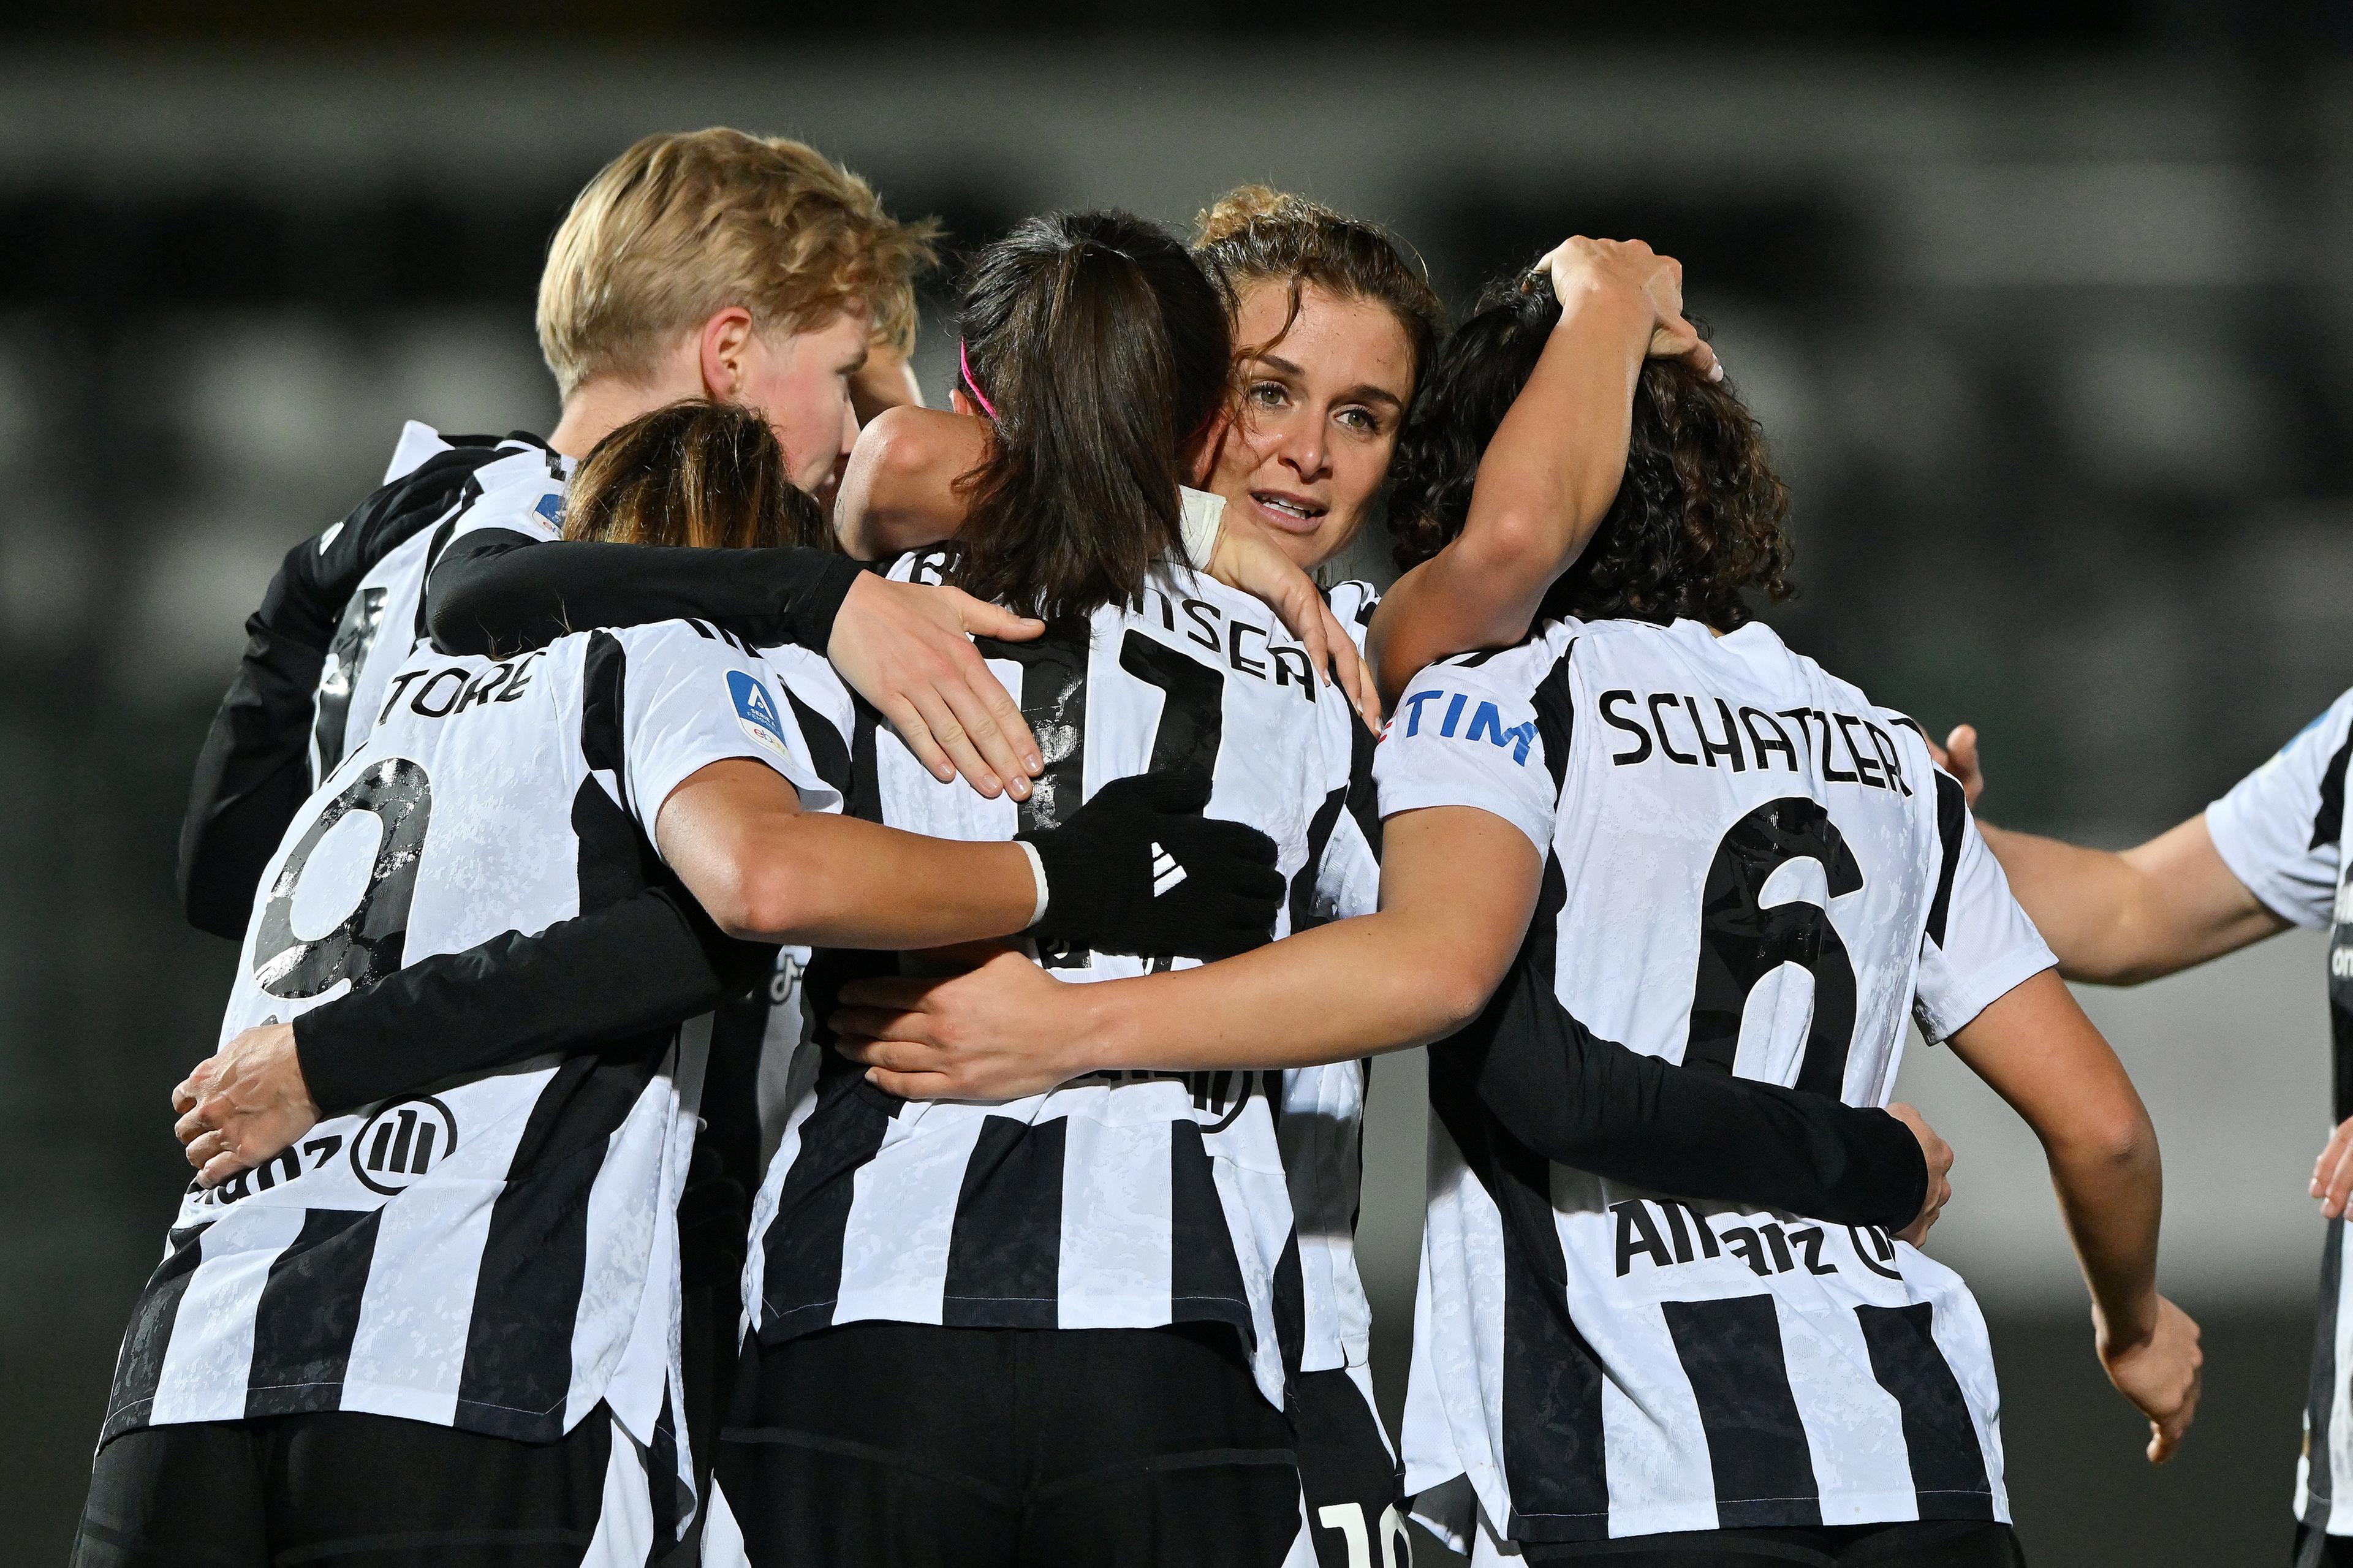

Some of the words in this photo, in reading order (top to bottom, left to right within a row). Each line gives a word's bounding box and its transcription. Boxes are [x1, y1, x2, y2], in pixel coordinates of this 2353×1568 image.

[377, 651, 547, 726] TORE
[1405, 690, 1539, 767] TIM
[1599, 689, 1914, 798] SCHATZER
[252, 757, 433, 1000] 9
[1681, 796, 1865, 1103] 6
